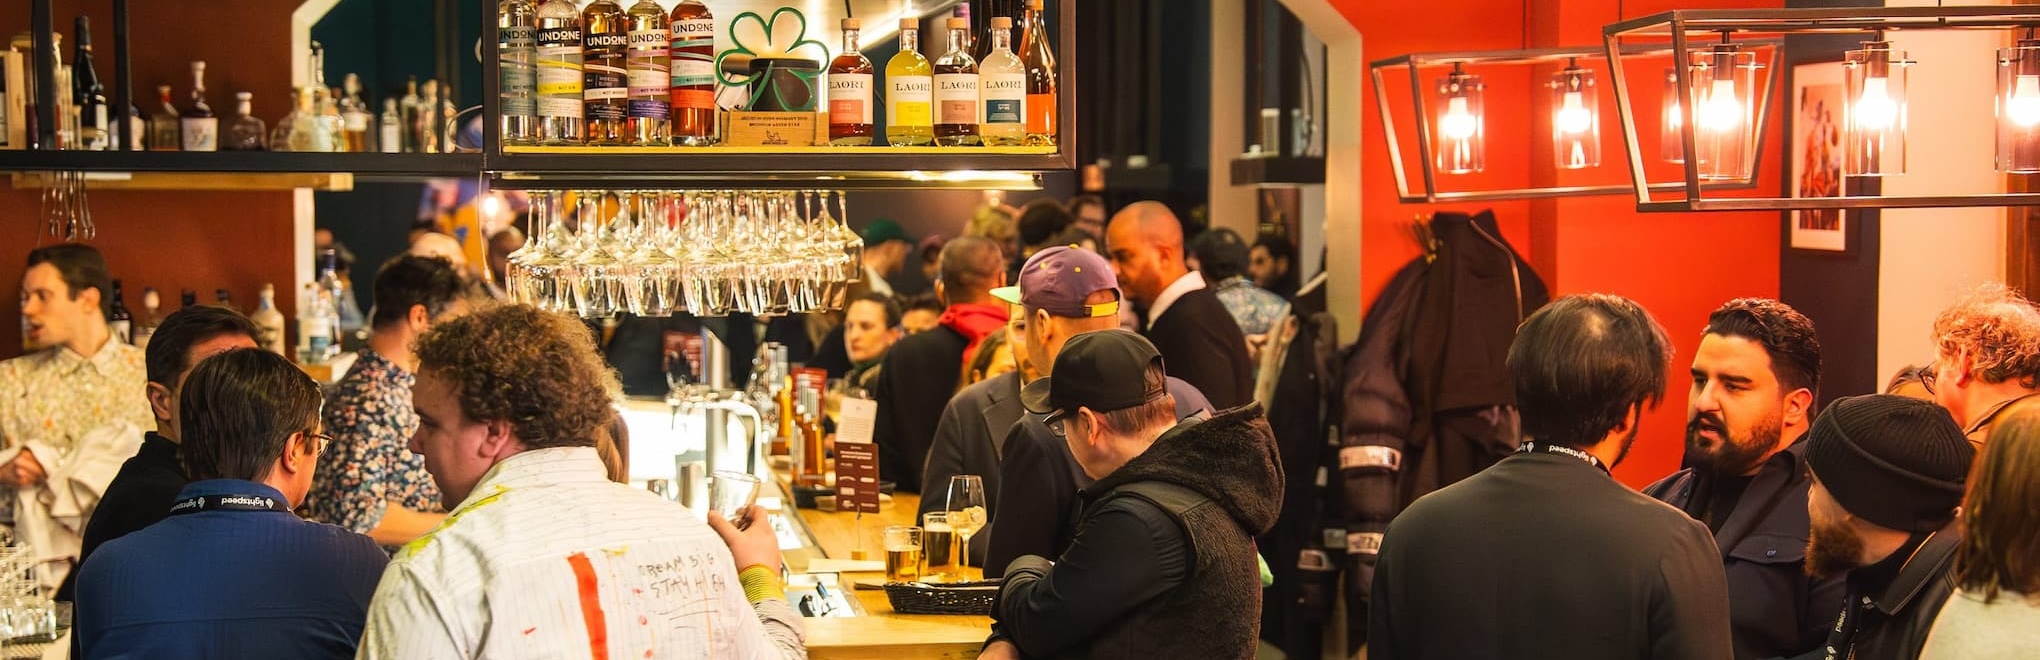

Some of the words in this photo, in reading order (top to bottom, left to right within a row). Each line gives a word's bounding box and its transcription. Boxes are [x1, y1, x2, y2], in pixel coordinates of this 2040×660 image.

[673, 23, 713, 34] UNDONE
[538, 30, 581, 42] UNDONE
[586, 35, 628, 47] UNDONE
[895, 82, 930, 91] LAORI
[941, 81, 976, 90] LAORI
[985, 80, 1021, 90] LAORI
[1548, 444, 1590, 462] lightspeed
[221, 496, 265, 507] lightspeed
